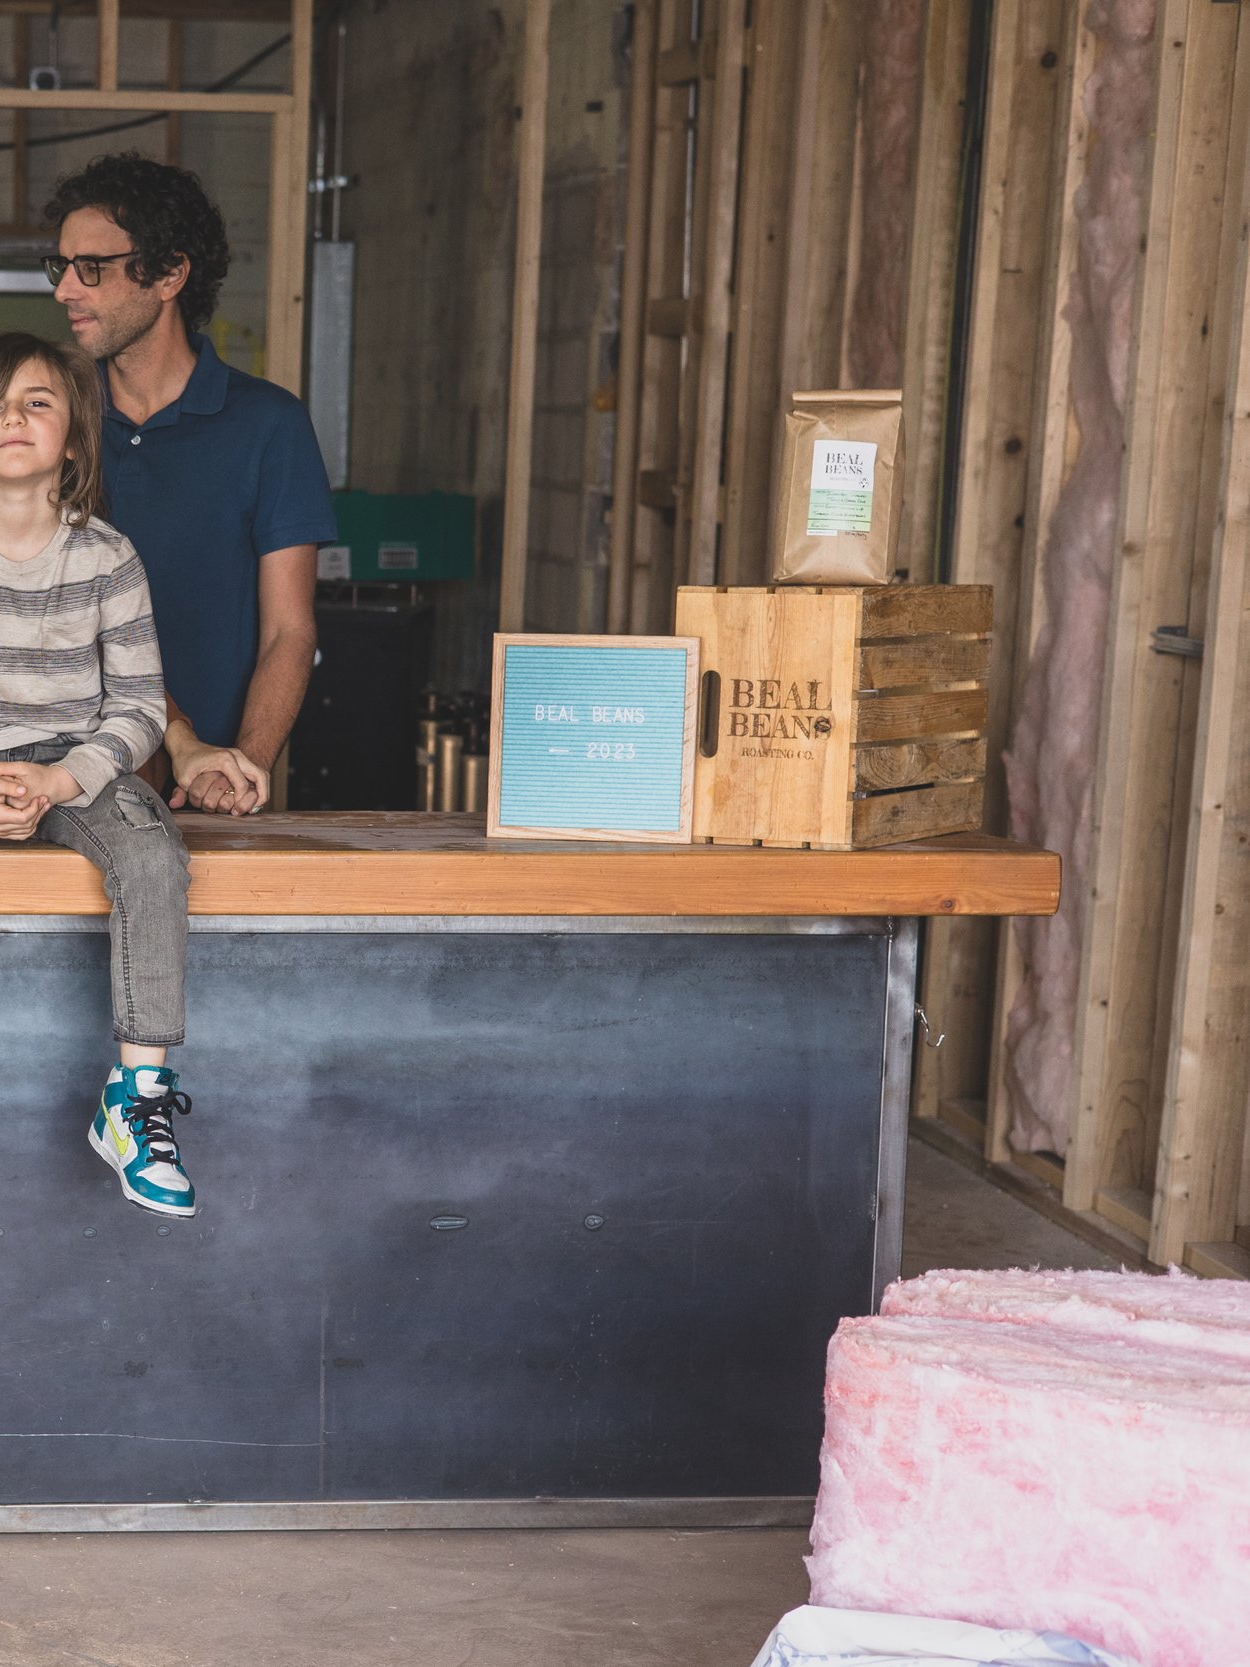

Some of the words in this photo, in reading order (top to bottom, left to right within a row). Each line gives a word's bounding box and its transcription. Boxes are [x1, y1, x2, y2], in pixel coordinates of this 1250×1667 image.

[826, 452, 864, 466] BEAL
[825, 464, 863, 475] BEANS
[728, 678, 833, 712] BEAL
[534, 704, 580, 722] BEAL
[592, 705, 646, 724] BEANS
[727, 712, 832, 742] BEANS
[587, 742, 636, 760] 2023
[741, 746, 795, 760] ROASTING
[797, 750, 814, 761] CO.
